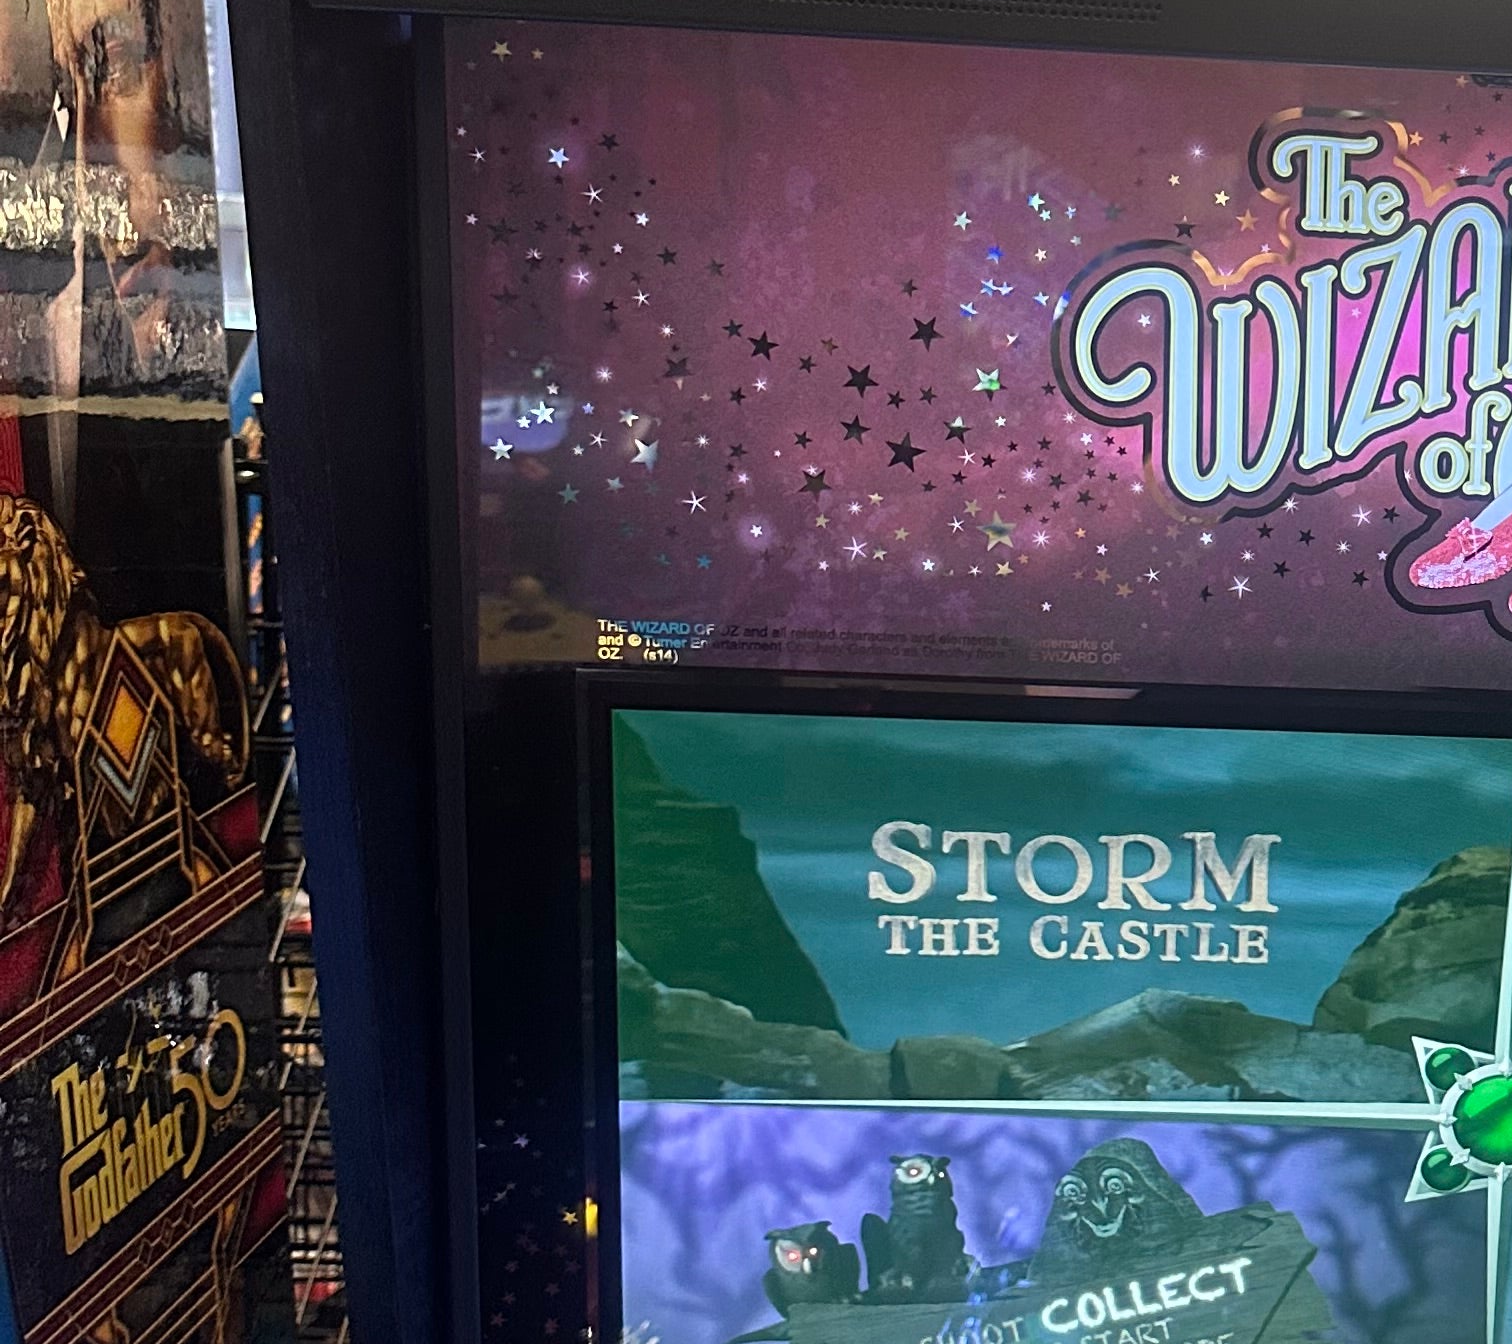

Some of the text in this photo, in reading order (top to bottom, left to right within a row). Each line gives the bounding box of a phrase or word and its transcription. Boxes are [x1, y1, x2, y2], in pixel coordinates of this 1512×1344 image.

[1273, 135, 1404, 234] The
[1420, 390, 1512, 496] of
[597, 619, 628, 633] THE
[631, 621, 691, 635] WIZARD
[694, 624, 716, 636] OF
[598, 634, 624, 647] and
[644, 635, 687, 649] Turner
[690, 637, 782, 654] Enertainment
[868, 820, 1282, 913] STORM
[878, 915, 1269, 964] THE CASTLE
[51, 1062, 109, 1159] The
[59, 1009, 246, 1256] Godfather 50
[1041, 1257, 1253, 1334] COLLECT
